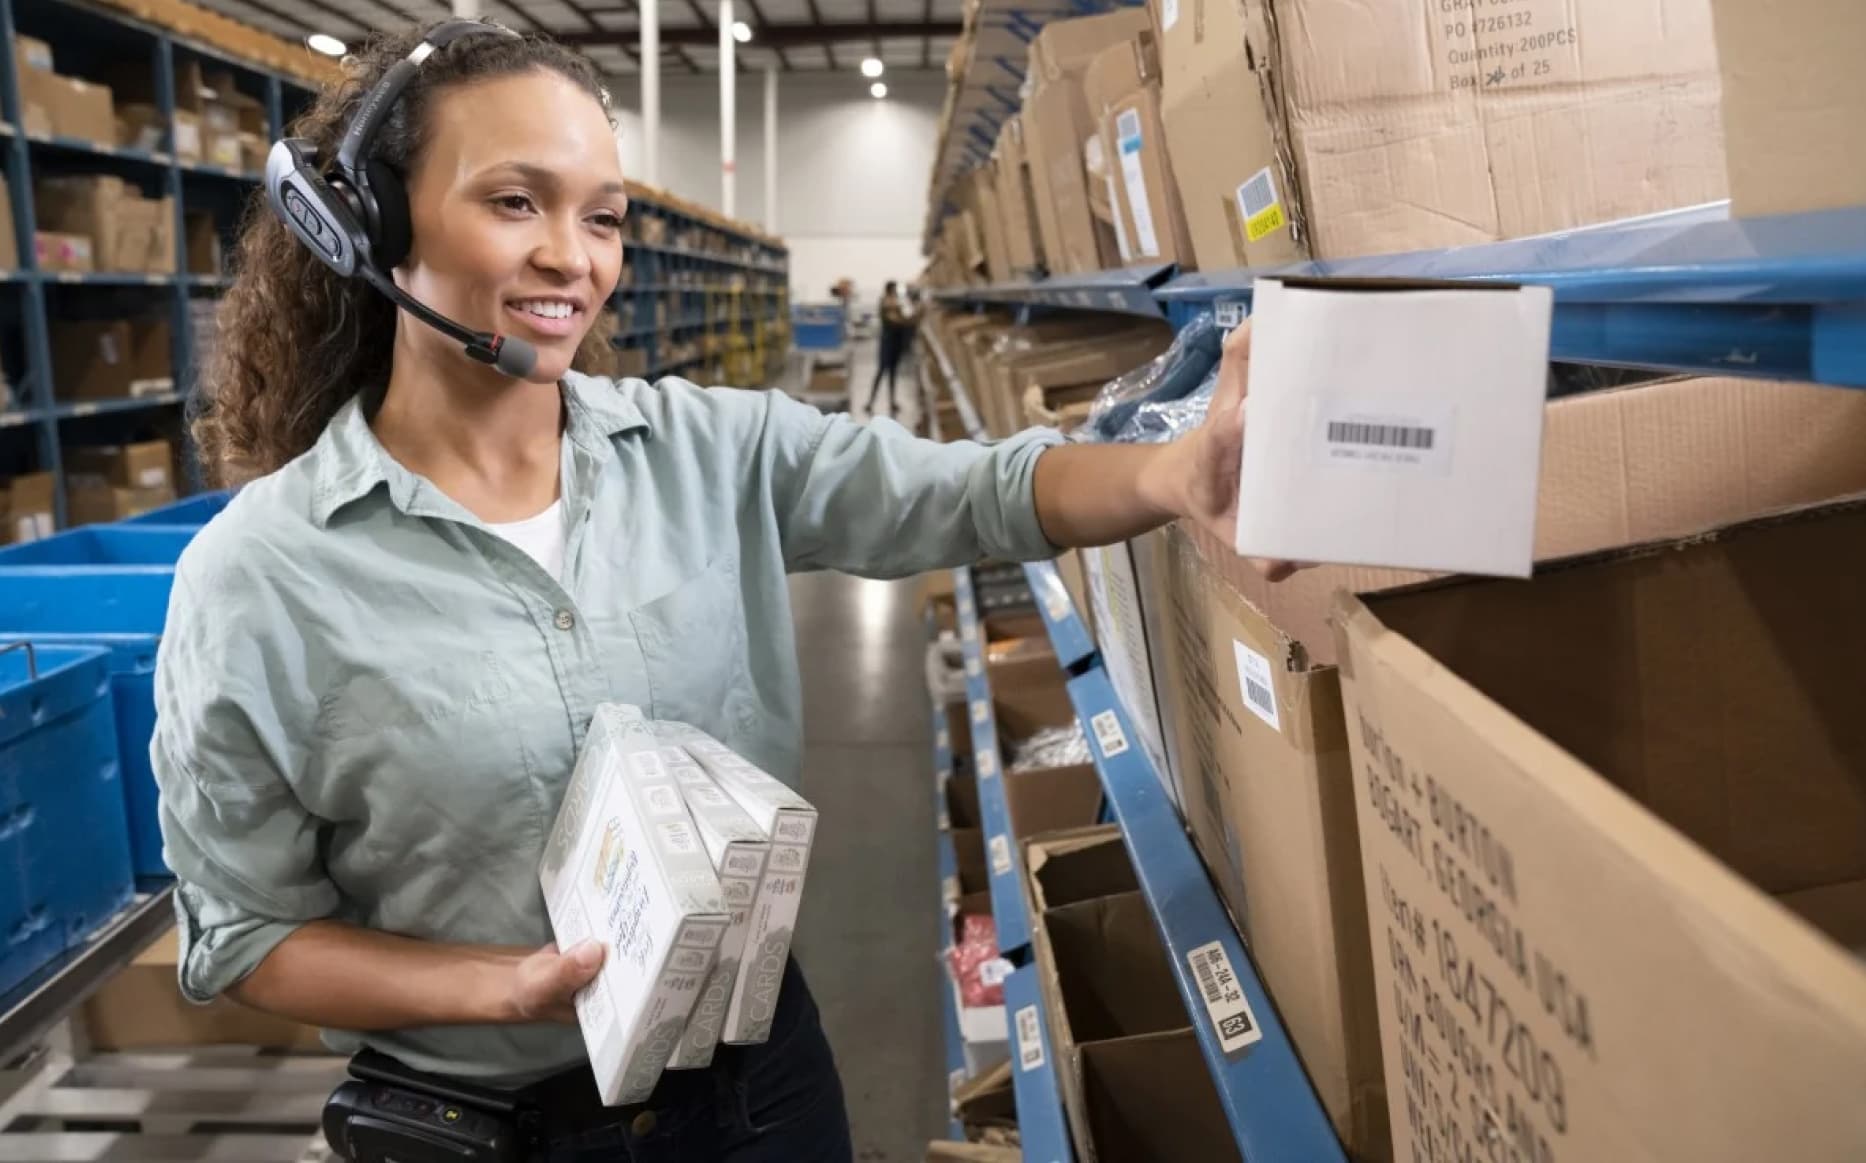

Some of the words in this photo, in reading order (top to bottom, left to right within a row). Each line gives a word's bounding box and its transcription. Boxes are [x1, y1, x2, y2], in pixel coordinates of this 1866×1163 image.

[1445, 22, 1465, 40] PO
[1511, 61, 1525, 79] of
[1533, 60, 1551, 76] 25
[1426, 772, 1519, 906] BURTON
[752, 940, 785, 1022] CARDS
[1432, 838, 1532, 990] GEORGIA
[1534, 948, 1599, 1064] USA
[1431, 917, 1567, 1137] 1847209
